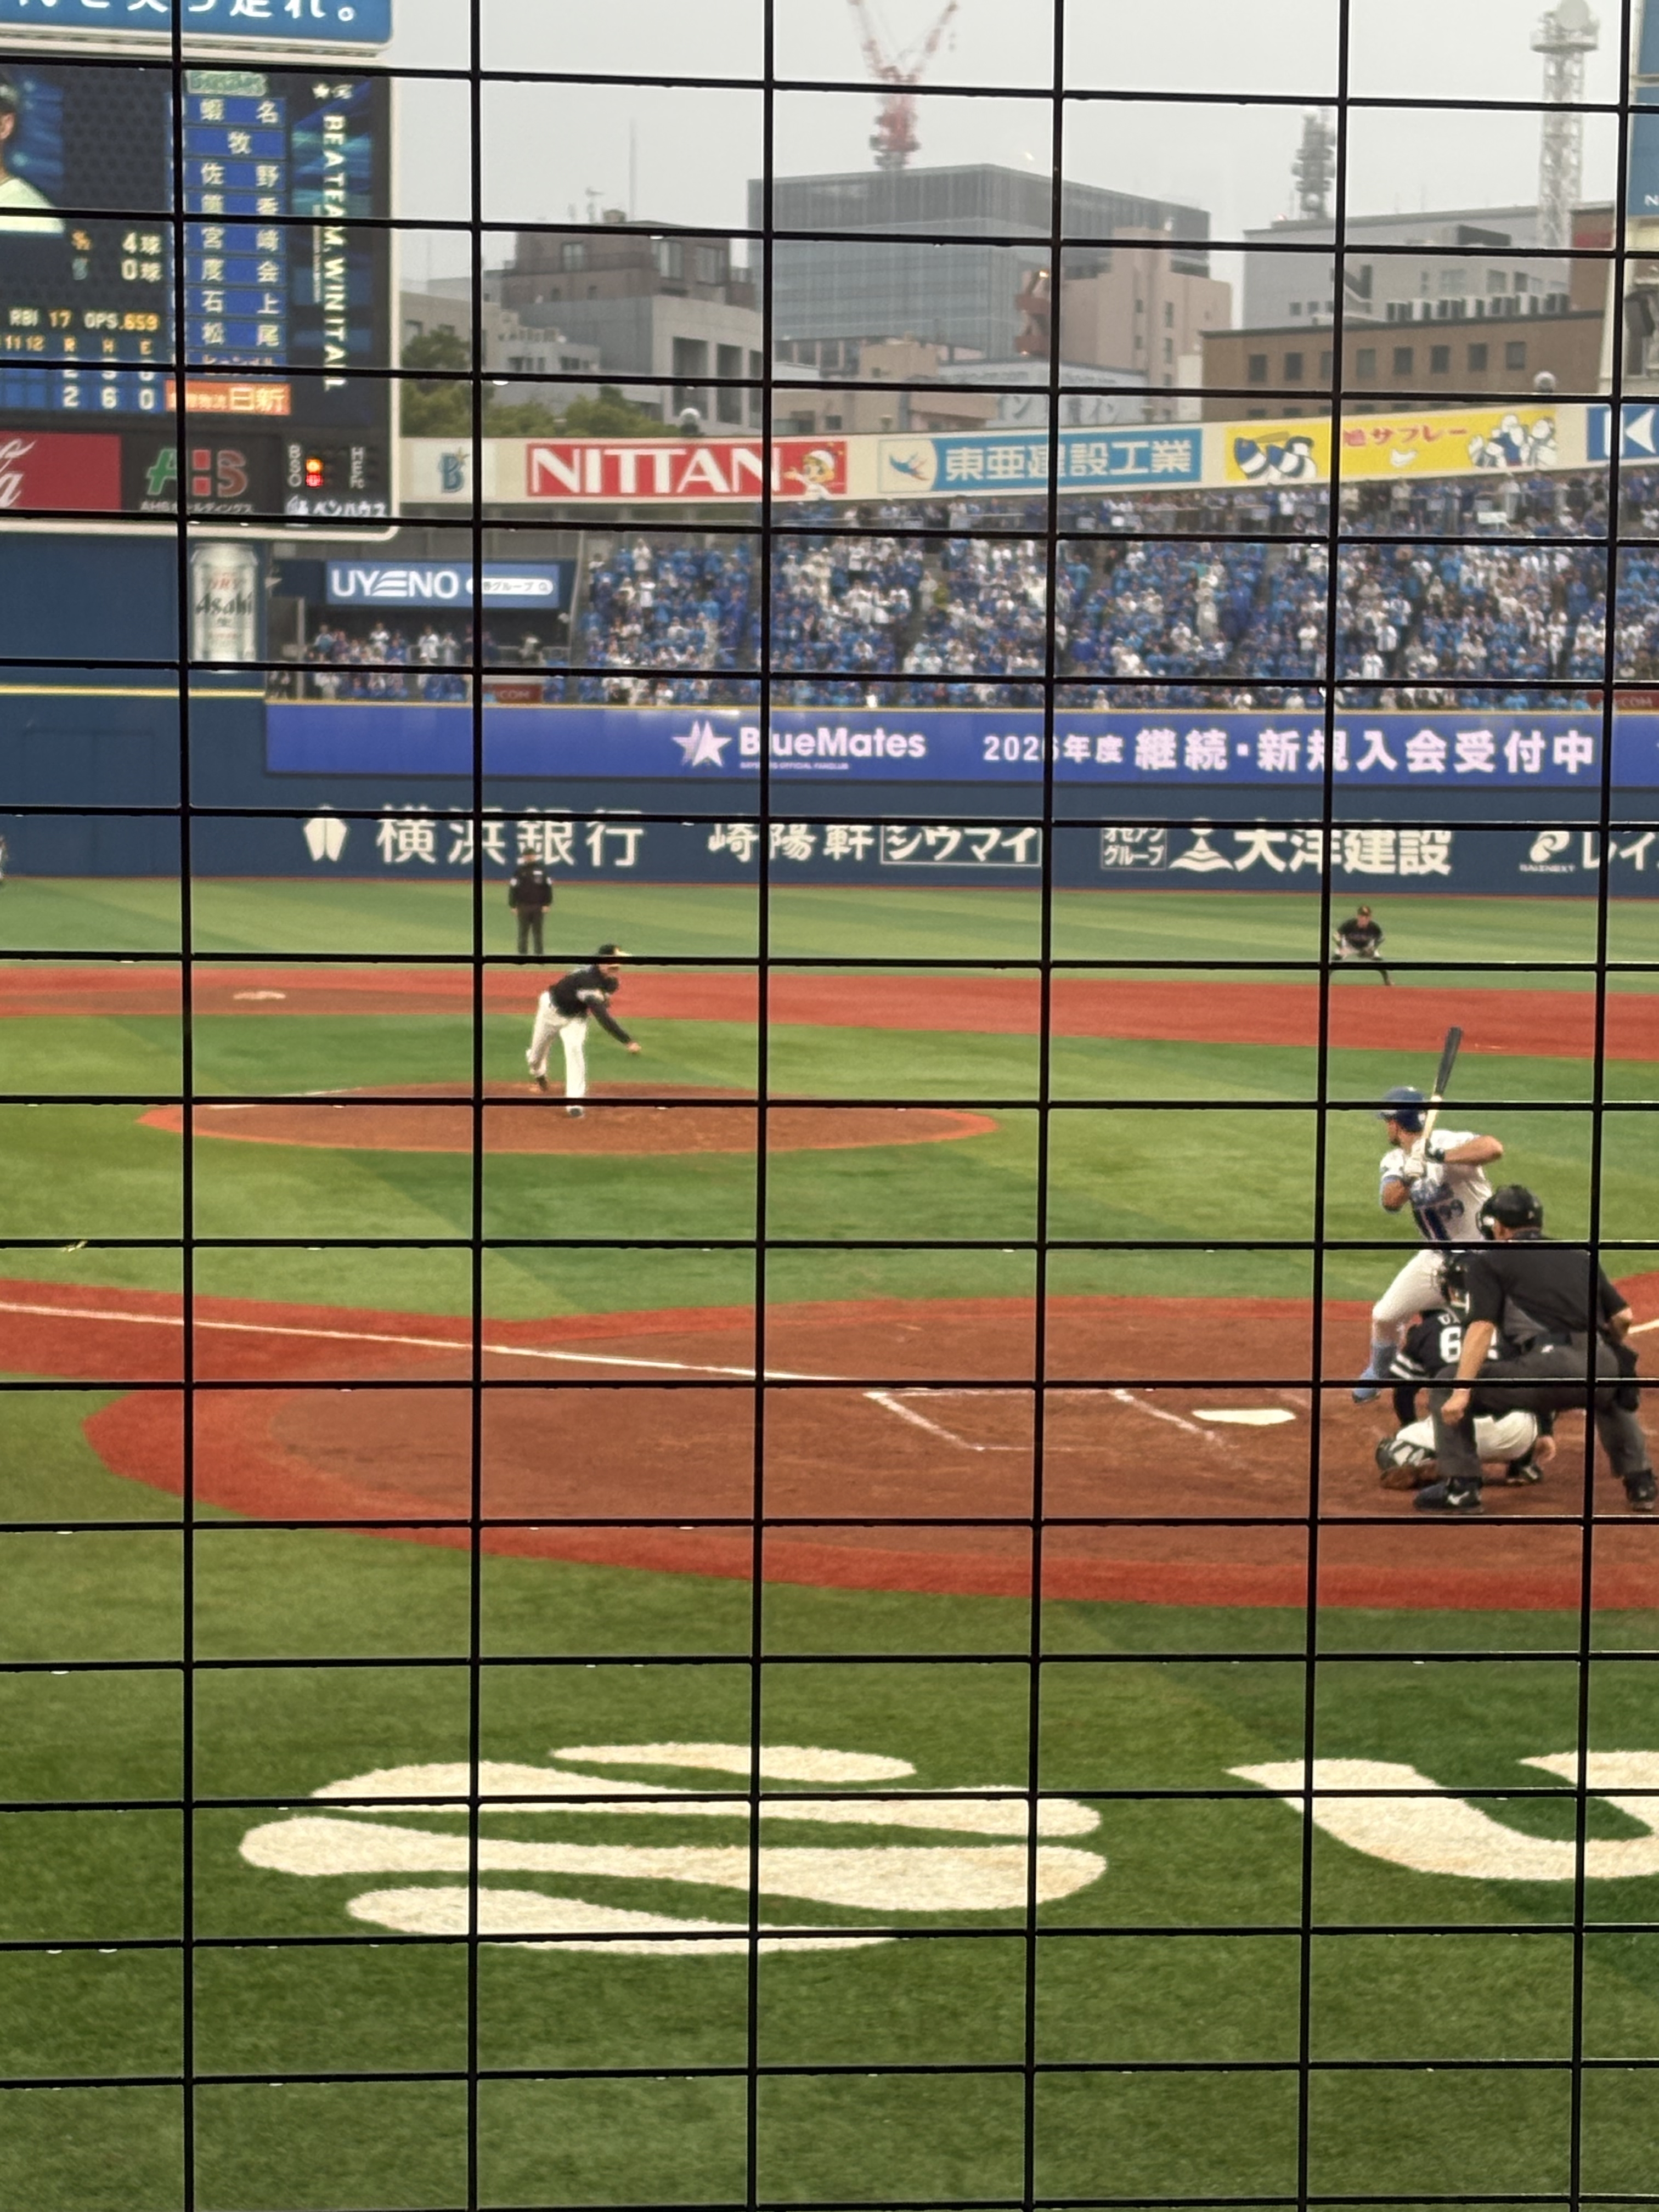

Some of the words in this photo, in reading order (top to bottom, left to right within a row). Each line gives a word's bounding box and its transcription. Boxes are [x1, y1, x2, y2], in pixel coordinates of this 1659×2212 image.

[228, 131, 252, 154] 牧
[201, 162, 279, 187] 佐野
[202, 290, 280, 314] 石上
[9, 309, 39, 326] RBI
[49, 309, 71, 328] 17
[84, 311, 119, 329] OPS
[64, 336, 76, 352] R
[140, 340, 153, 356] E
[202, 323, 279, 347] 松尾
[63, 386, 79, 407] 2
[101, 387, 117, 409] 6
[139, 388, 155, 410] 0
[532, 448, 781, 493] NITTAN
[945, 439, 1192, 482] 東亜建設工業
[331, 569, 459, 599] UYENO
[195, 591, 253, 614] Asahi
[740, 727, 926, 757] BueMates
[376, 804, 643, 866] 横浜銀行
[885, 822, 1037, 863] シウマイ
[1104, 845, 1165, 866] グループ
[1583, 828, 1659, 871] レイ
